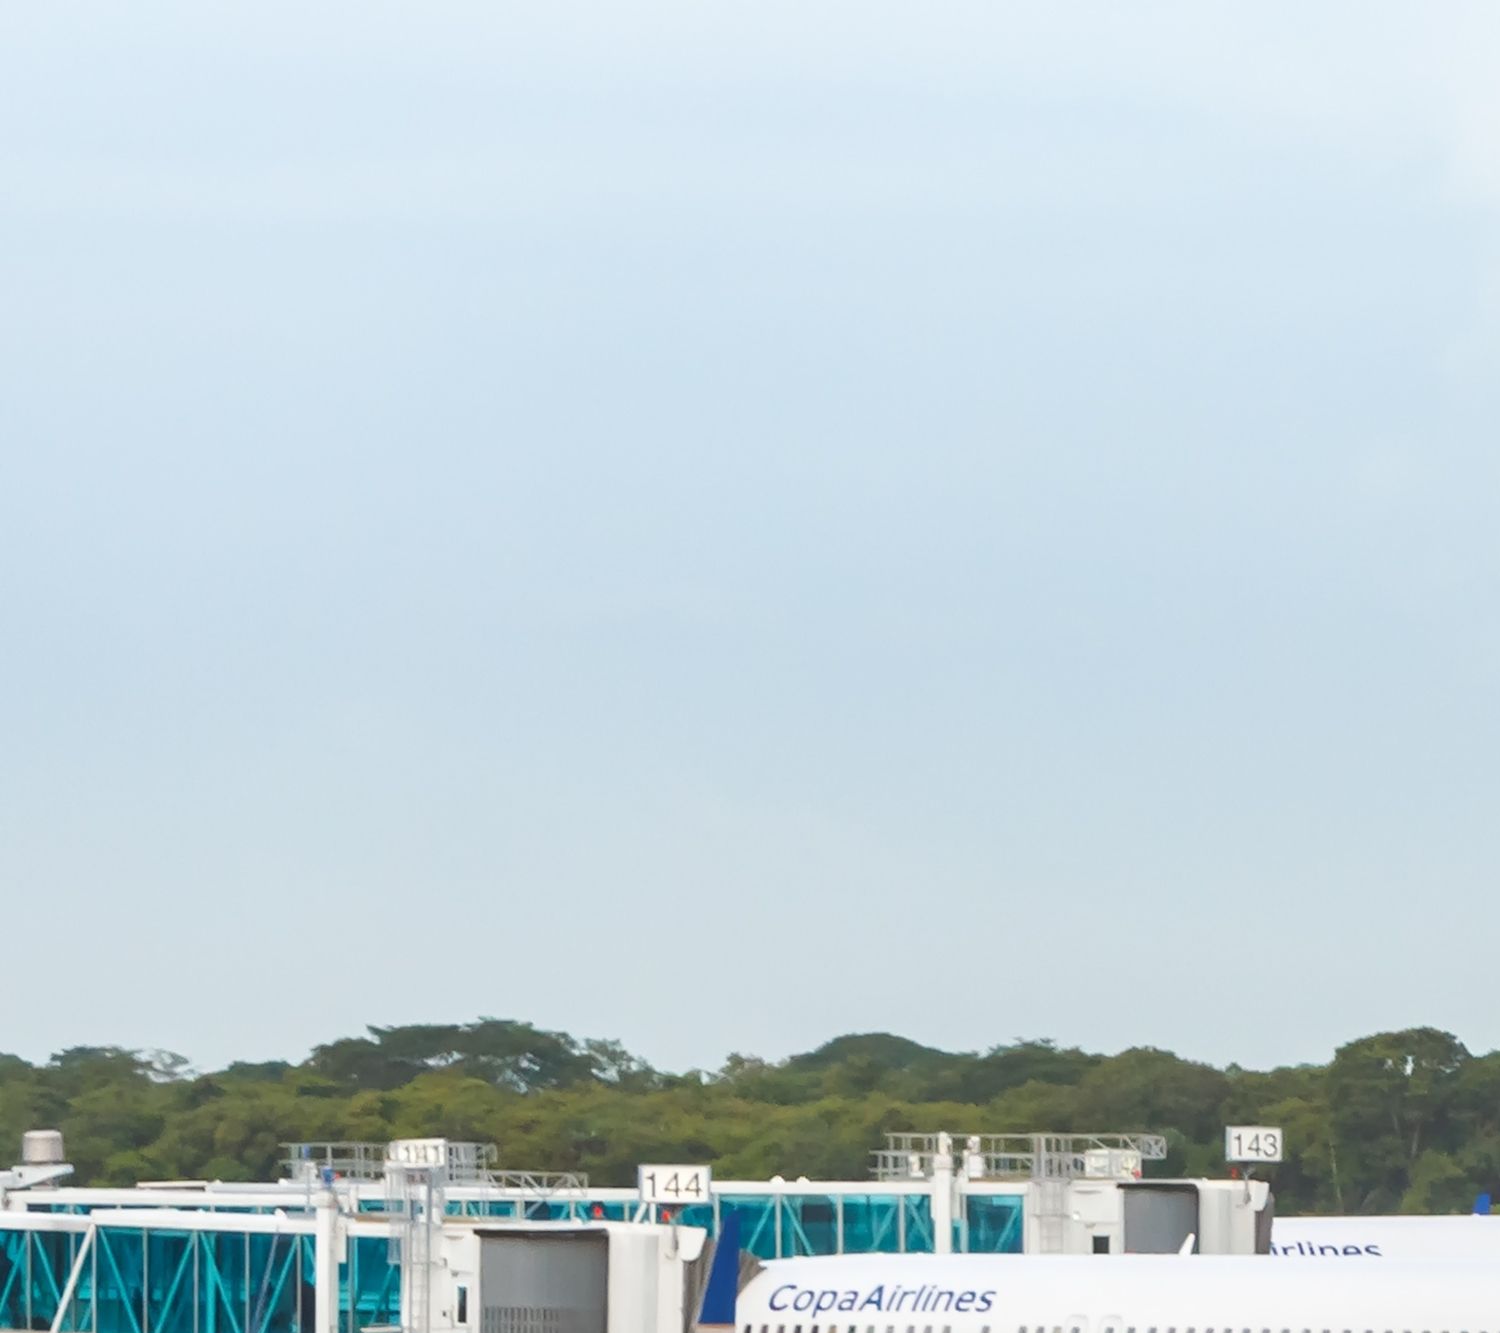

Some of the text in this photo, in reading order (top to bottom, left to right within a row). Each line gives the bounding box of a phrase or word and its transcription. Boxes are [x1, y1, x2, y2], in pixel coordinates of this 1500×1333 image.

[1234, 1134, 1278, 1157] 143
[646, 1172, 702, 1197] 144
[768, 1284, 997, 1318] CopaAirlines
